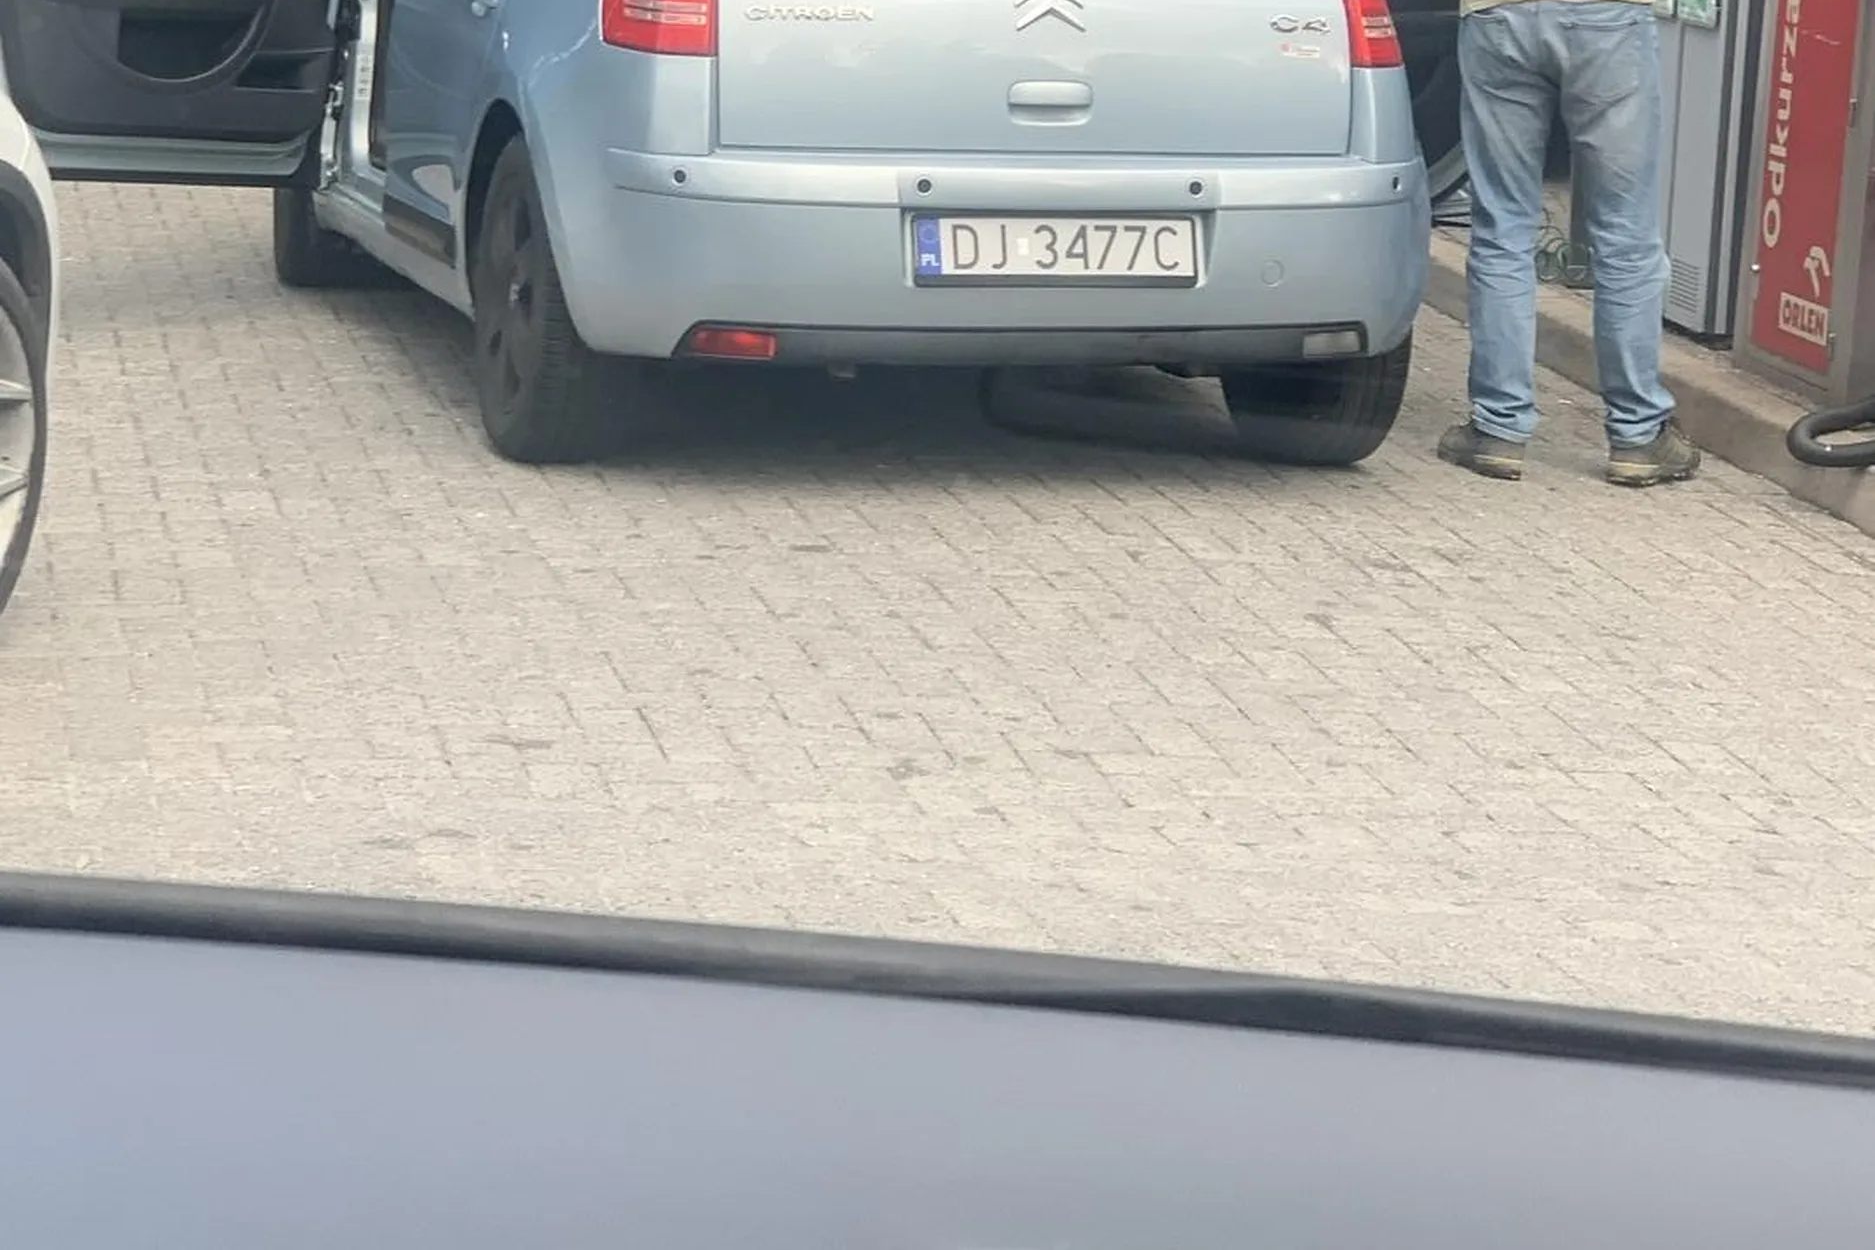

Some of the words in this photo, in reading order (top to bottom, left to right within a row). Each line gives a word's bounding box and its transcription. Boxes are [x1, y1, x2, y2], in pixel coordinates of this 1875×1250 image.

[1269, 15, 1331, 35] C4
[921, 254, 939, 267] PL
[951, 224, 1007, 270] DJ
[1034, 224, 1180, 271] 3477C
[1783, 298, 1825, 342] ORLEN
